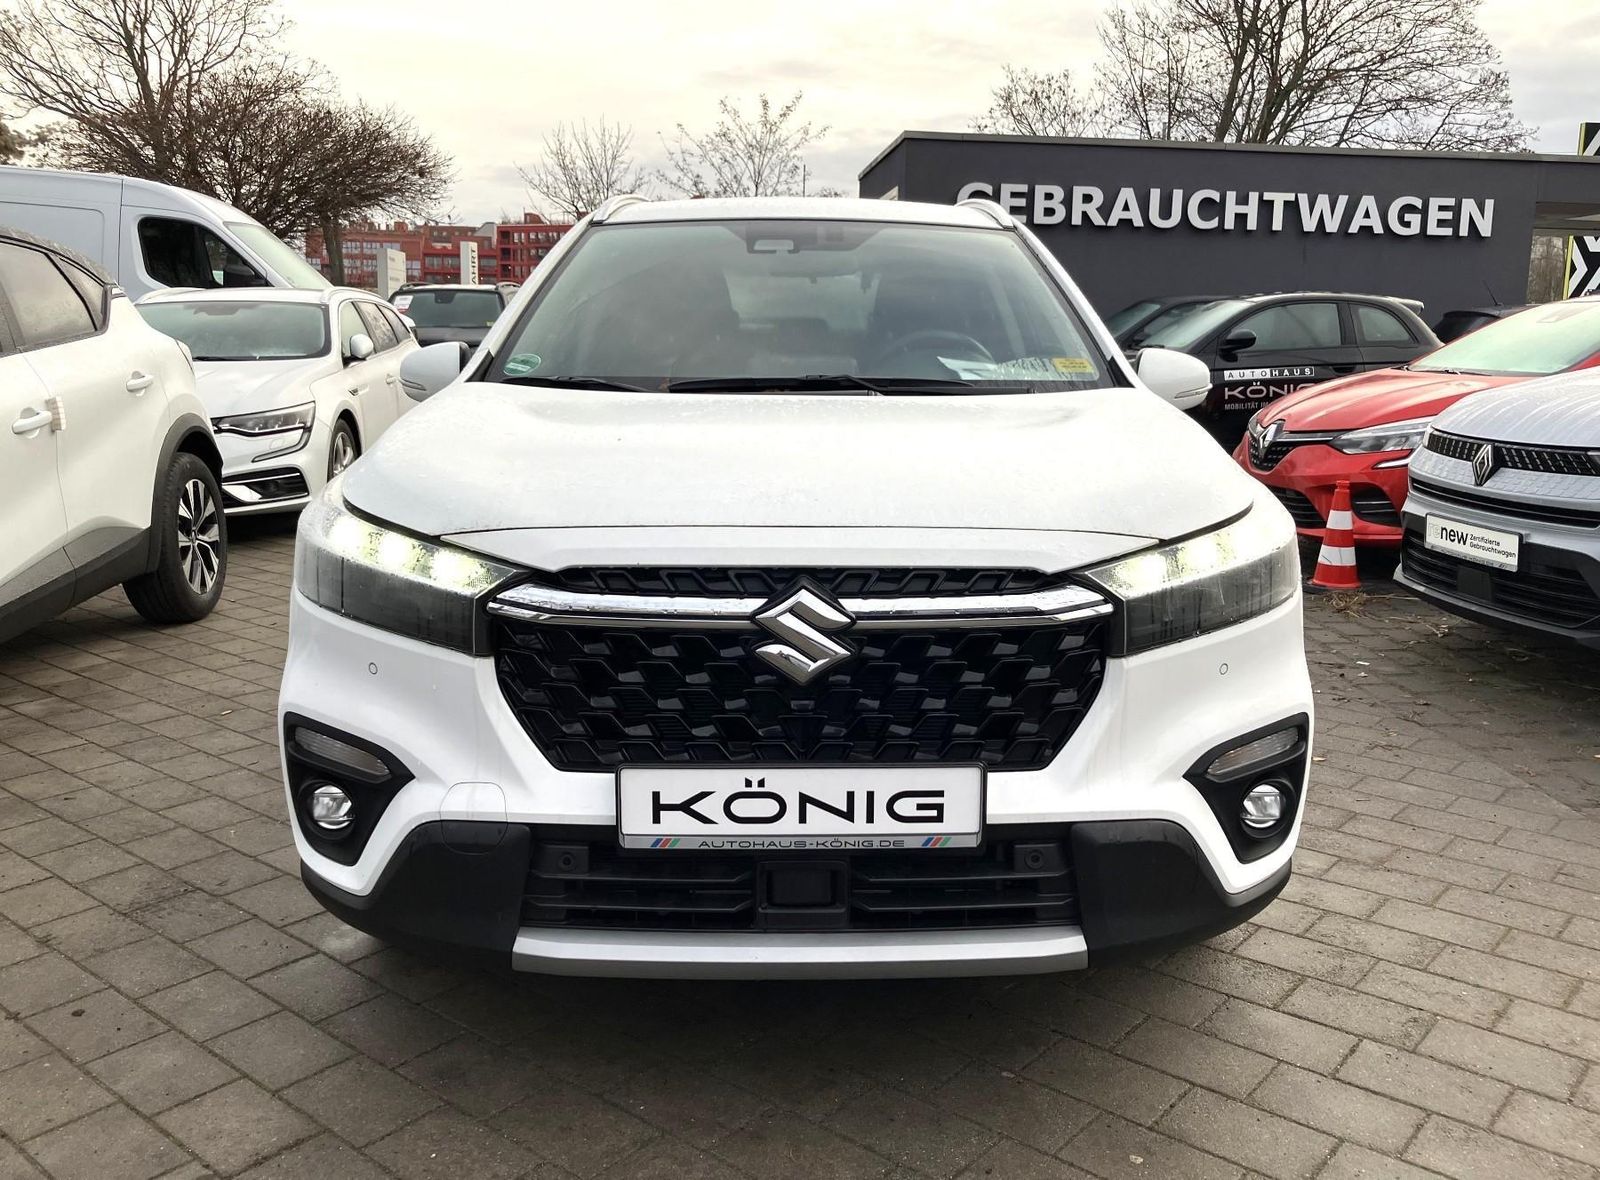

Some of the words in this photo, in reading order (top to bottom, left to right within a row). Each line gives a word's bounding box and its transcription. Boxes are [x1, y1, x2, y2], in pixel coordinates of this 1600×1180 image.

[1227, 367, 1312, 379] AUTOHAUS
[1224, 401, 1259, 411] MOBILITÄT
[1469, 533, 1501, 547] Zertifizierte
[1469, 541, 1517, 558] Gebrauchtwagen
[651, 776, 946, 825] KÖNIG
[697, 837, 906, 849] AUTOHAUS-KÖNIG.DE
